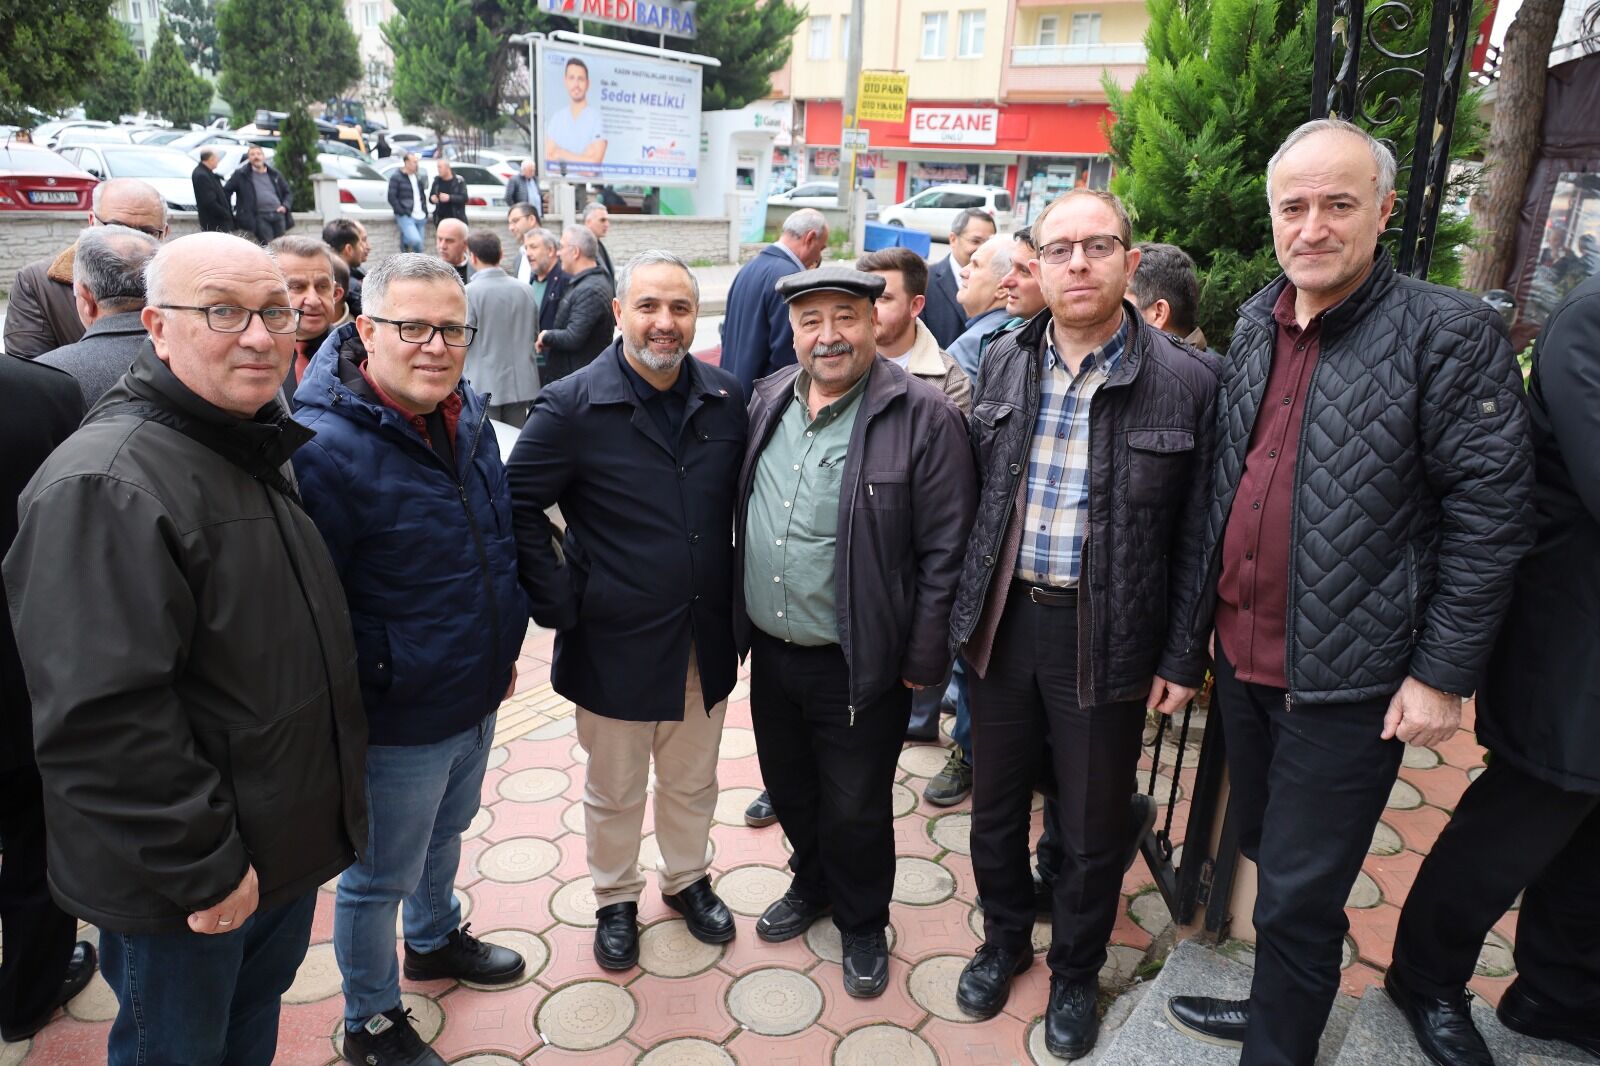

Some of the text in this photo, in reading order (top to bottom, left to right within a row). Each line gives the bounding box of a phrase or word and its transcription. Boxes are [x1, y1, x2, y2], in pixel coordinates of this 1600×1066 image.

[864, 83, 904, 94] OTO PARK
[600, 88, 685, 109] Sedat MELİKLİ
[862, 101, 903, 111] OTO YIKAMA
[915, 114, 992, 131] ECZANE
[815, 151, 890, 168] ECANE
